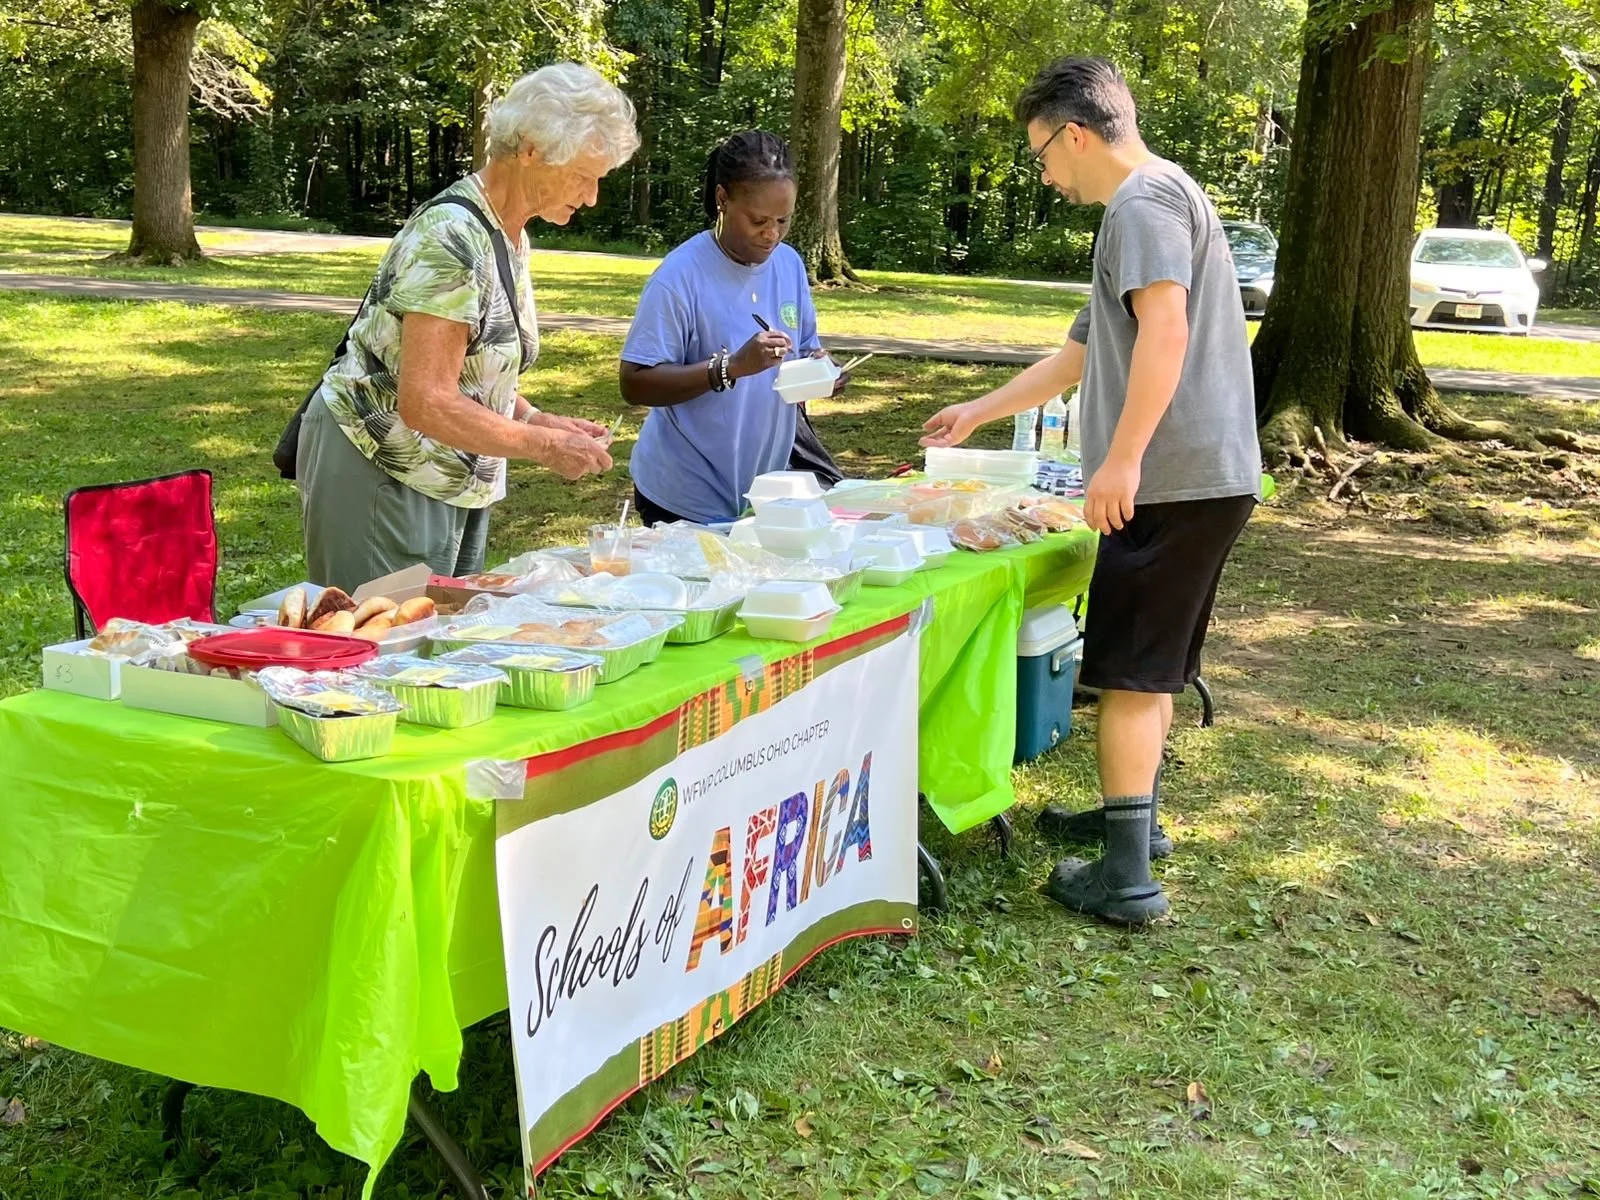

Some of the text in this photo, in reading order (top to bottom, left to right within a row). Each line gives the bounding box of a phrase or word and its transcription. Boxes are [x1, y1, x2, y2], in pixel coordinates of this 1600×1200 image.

[682, 719, 830, 806] WFWP COLUMBUS OHIO CHAPTER
[527, 750, 873, 1038] Schools of AFRICA
